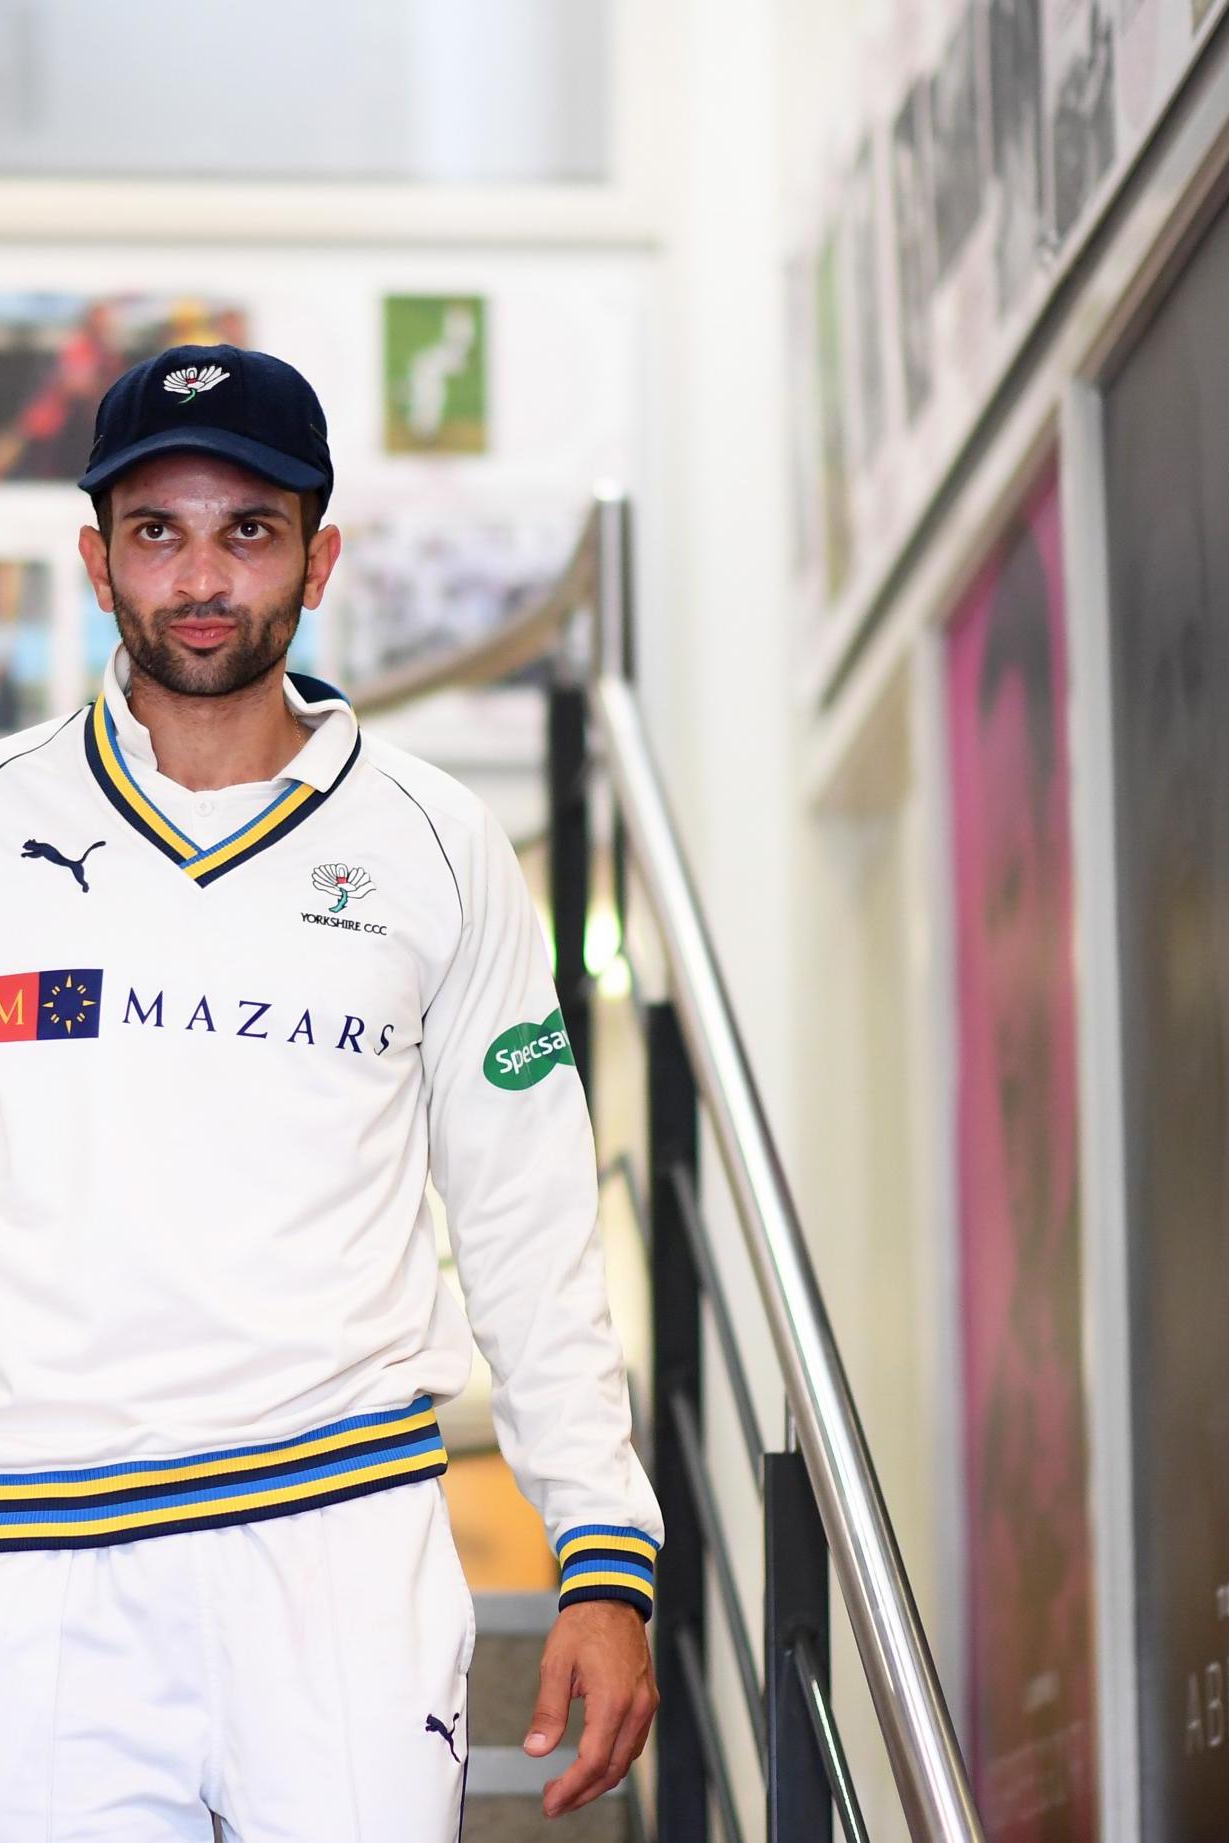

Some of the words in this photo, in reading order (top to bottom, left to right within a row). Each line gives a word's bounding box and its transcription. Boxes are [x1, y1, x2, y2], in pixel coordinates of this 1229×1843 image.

[300, 912, 361, 931] YORKSHIRE
[363, 923, 387, 936] CCC
[122, 987, 394, 1056] MAZARS
